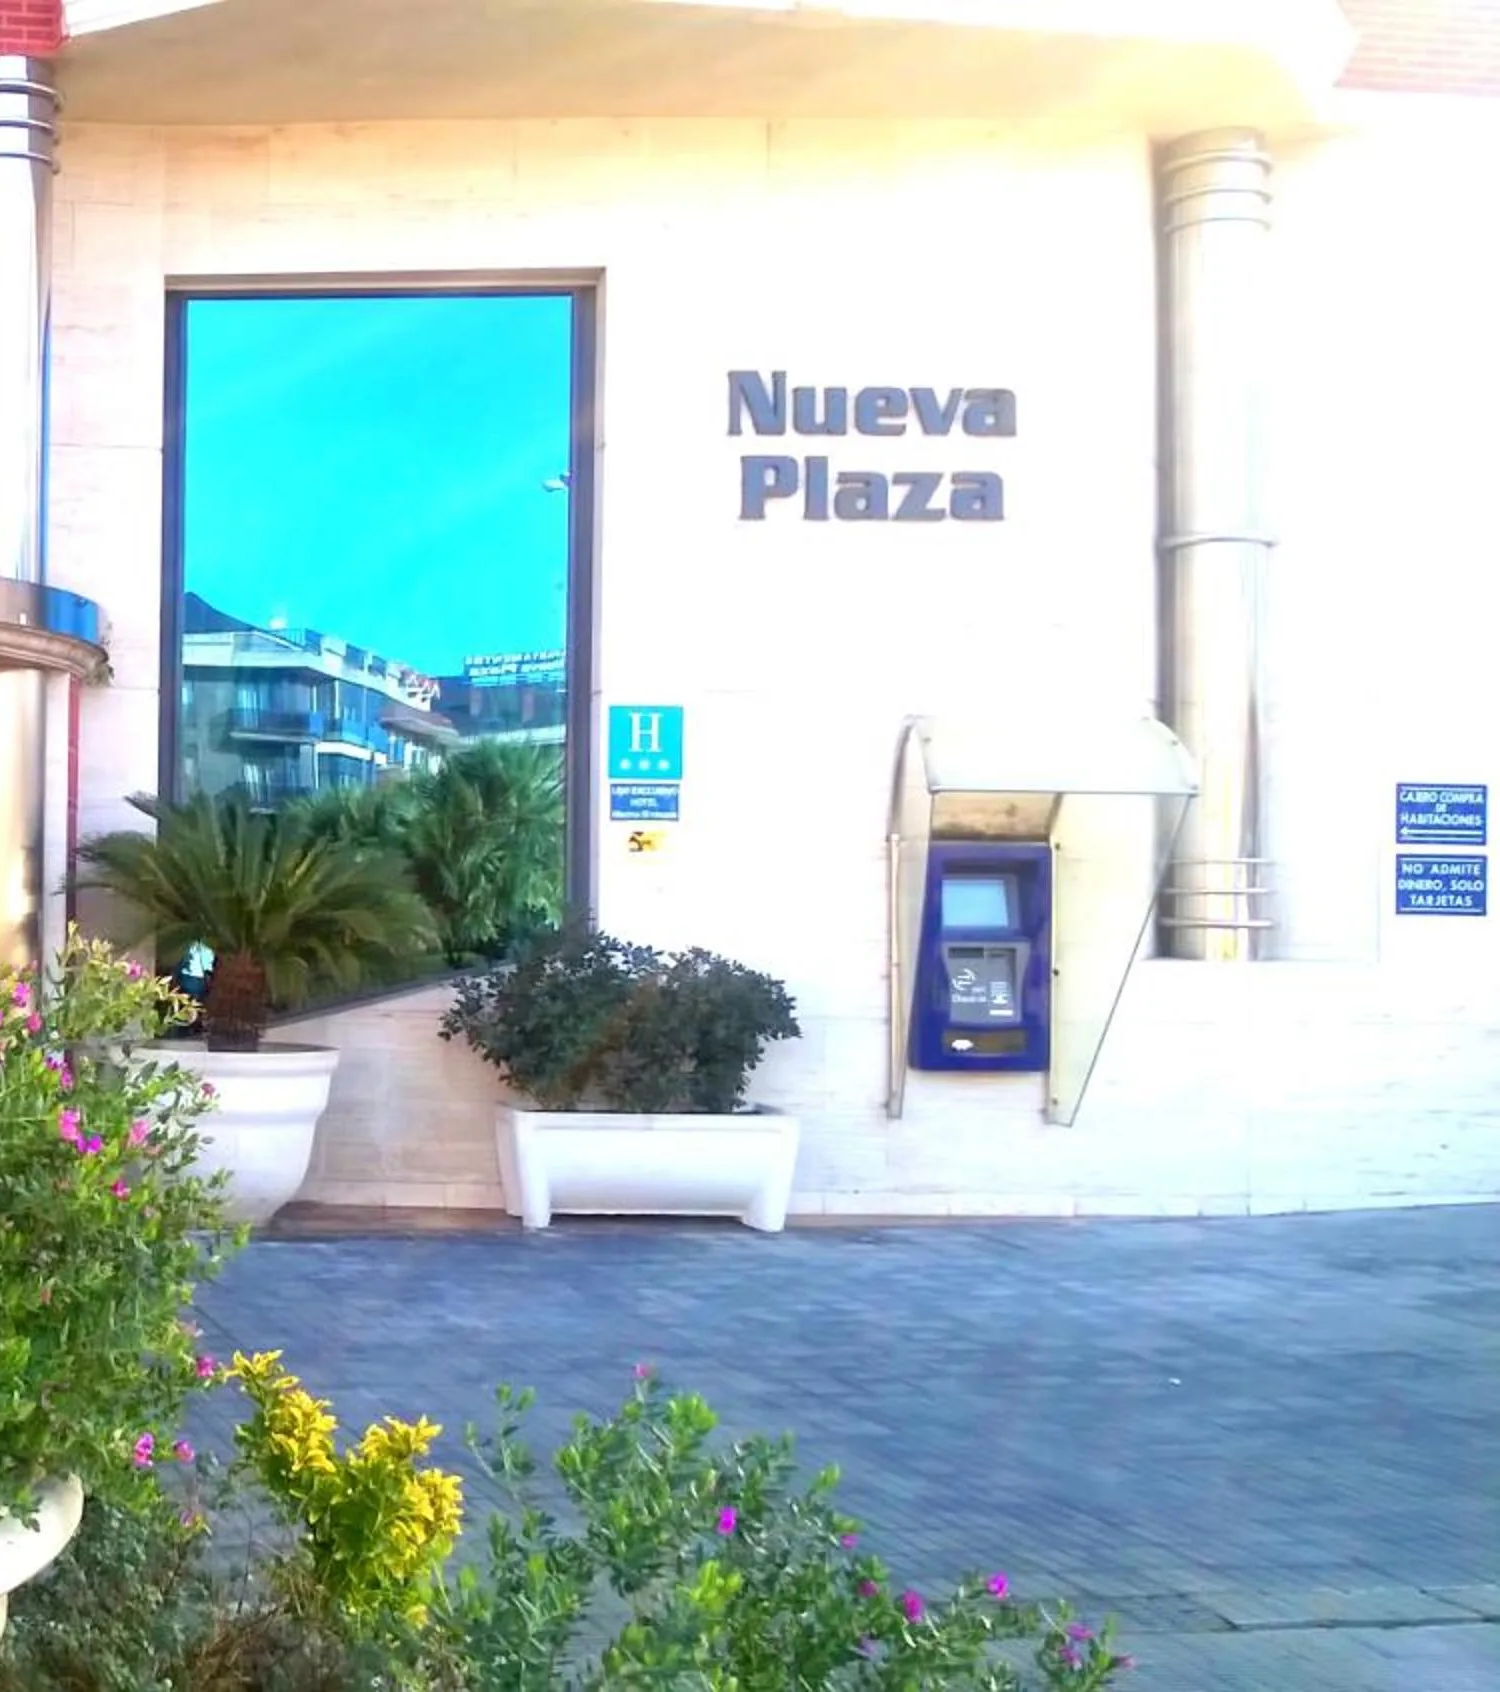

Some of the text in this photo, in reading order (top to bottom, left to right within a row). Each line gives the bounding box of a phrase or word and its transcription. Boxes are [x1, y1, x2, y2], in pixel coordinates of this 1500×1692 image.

[727, 370, 1017, 437] Nueva
[739, 455, 1005, 521] Plaza
[628, 712, 663, 752] H
[1439, 791, 1484, 804] COMPRA
[1400, 813, 1482, 826] HABITACIONES
[1402, 863, 1481, 875] NO ADMITE
[1449, 879, 1484, 891] SOLO
[1410, 894, 1473, 907] TARJETAS
